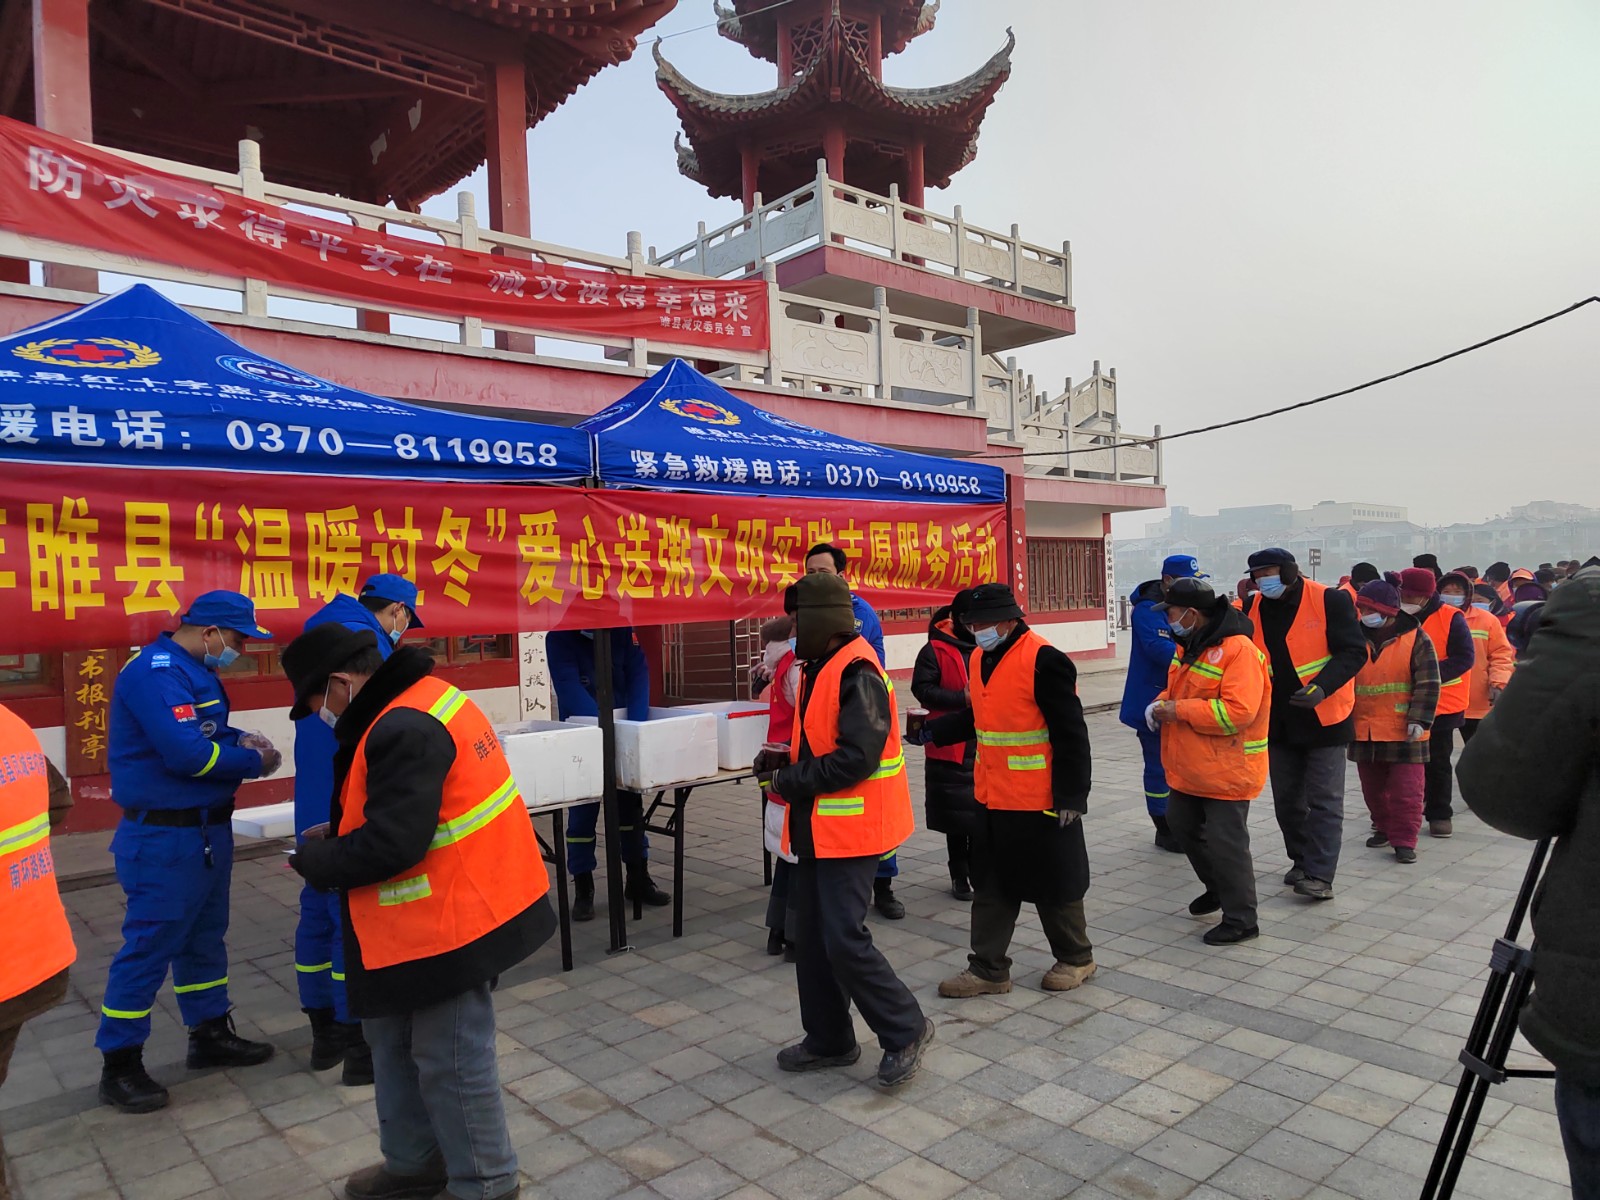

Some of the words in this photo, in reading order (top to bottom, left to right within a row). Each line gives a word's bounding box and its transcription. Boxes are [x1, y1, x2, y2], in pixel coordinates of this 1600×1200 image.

[488, 268, 749, 322] 减灾换得幸福来
[660, 316, 735, 336] 睢县减灾委员会
[741, 325, 752, 337] 宣
[0, 496, 999, 620] 睢县“温暖过冬”爱心送粥文明实志愿服务活动
[74, 648, 109, 760] 书报刊亭
